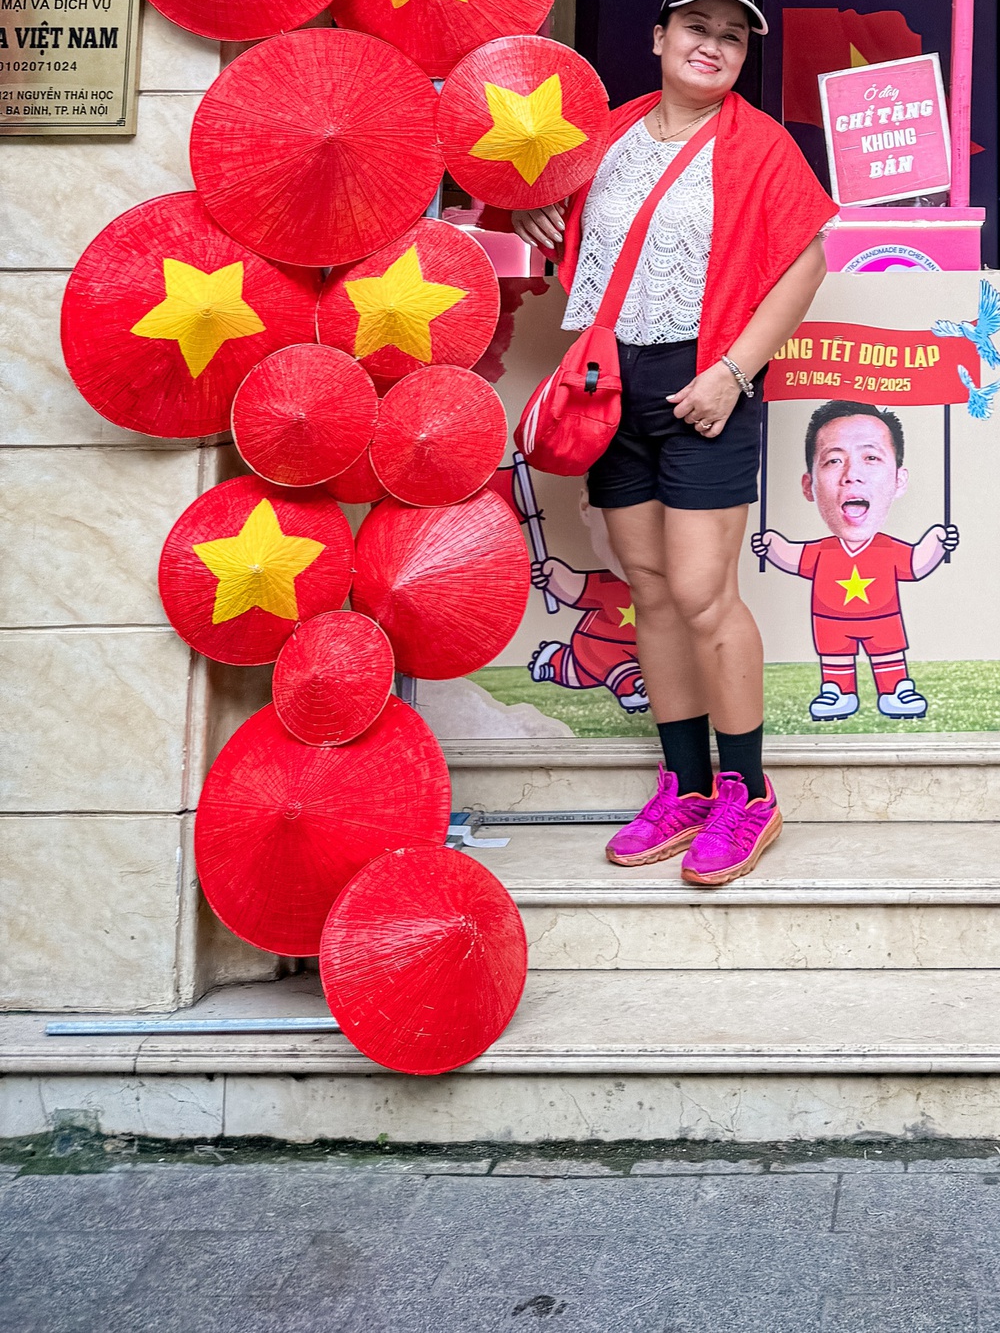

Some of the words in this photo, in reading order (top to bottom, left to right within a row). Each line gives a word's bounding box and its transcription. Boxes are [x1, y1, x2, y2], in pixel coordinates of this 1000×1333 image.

[1, 0, 27, 13] MẠI
[54, 0, 88, 13] DỊCH
[92, 0, 112, 13] VỤ
[15, 20, 64, 56] VIỆT
[67, 27, 119, 49] NAM
[17, 86, 61, 100] NGUYỄN
[64, 88, 88, 100] THÁI
[91, 90, 114, 102] HỌC
[863, 84, 878, 101] Ở
[878, 84, 900, 102] đây
[6, 105, 20, 115] BA
[54, 105, 70, 115] TP.
[72, 103, 87, 115] HÀ
[90, 103, 108, 116] NỘI
[877, 99, 934, 126] TẶNG
[861, 127, 918, 154] KHÔNG
[868, 154, 914, 179] BÁN
[860, 246, 898, 262] HANDMADE
[820, 335, 855, 363] TẾT
[859, 342, 898, 369] ĐỘC
[904, 344, 940, 371] LẬP
[785, 370, 842, 386] 2/9/1945
[854, 376, 912, 393] 2/9/2025
